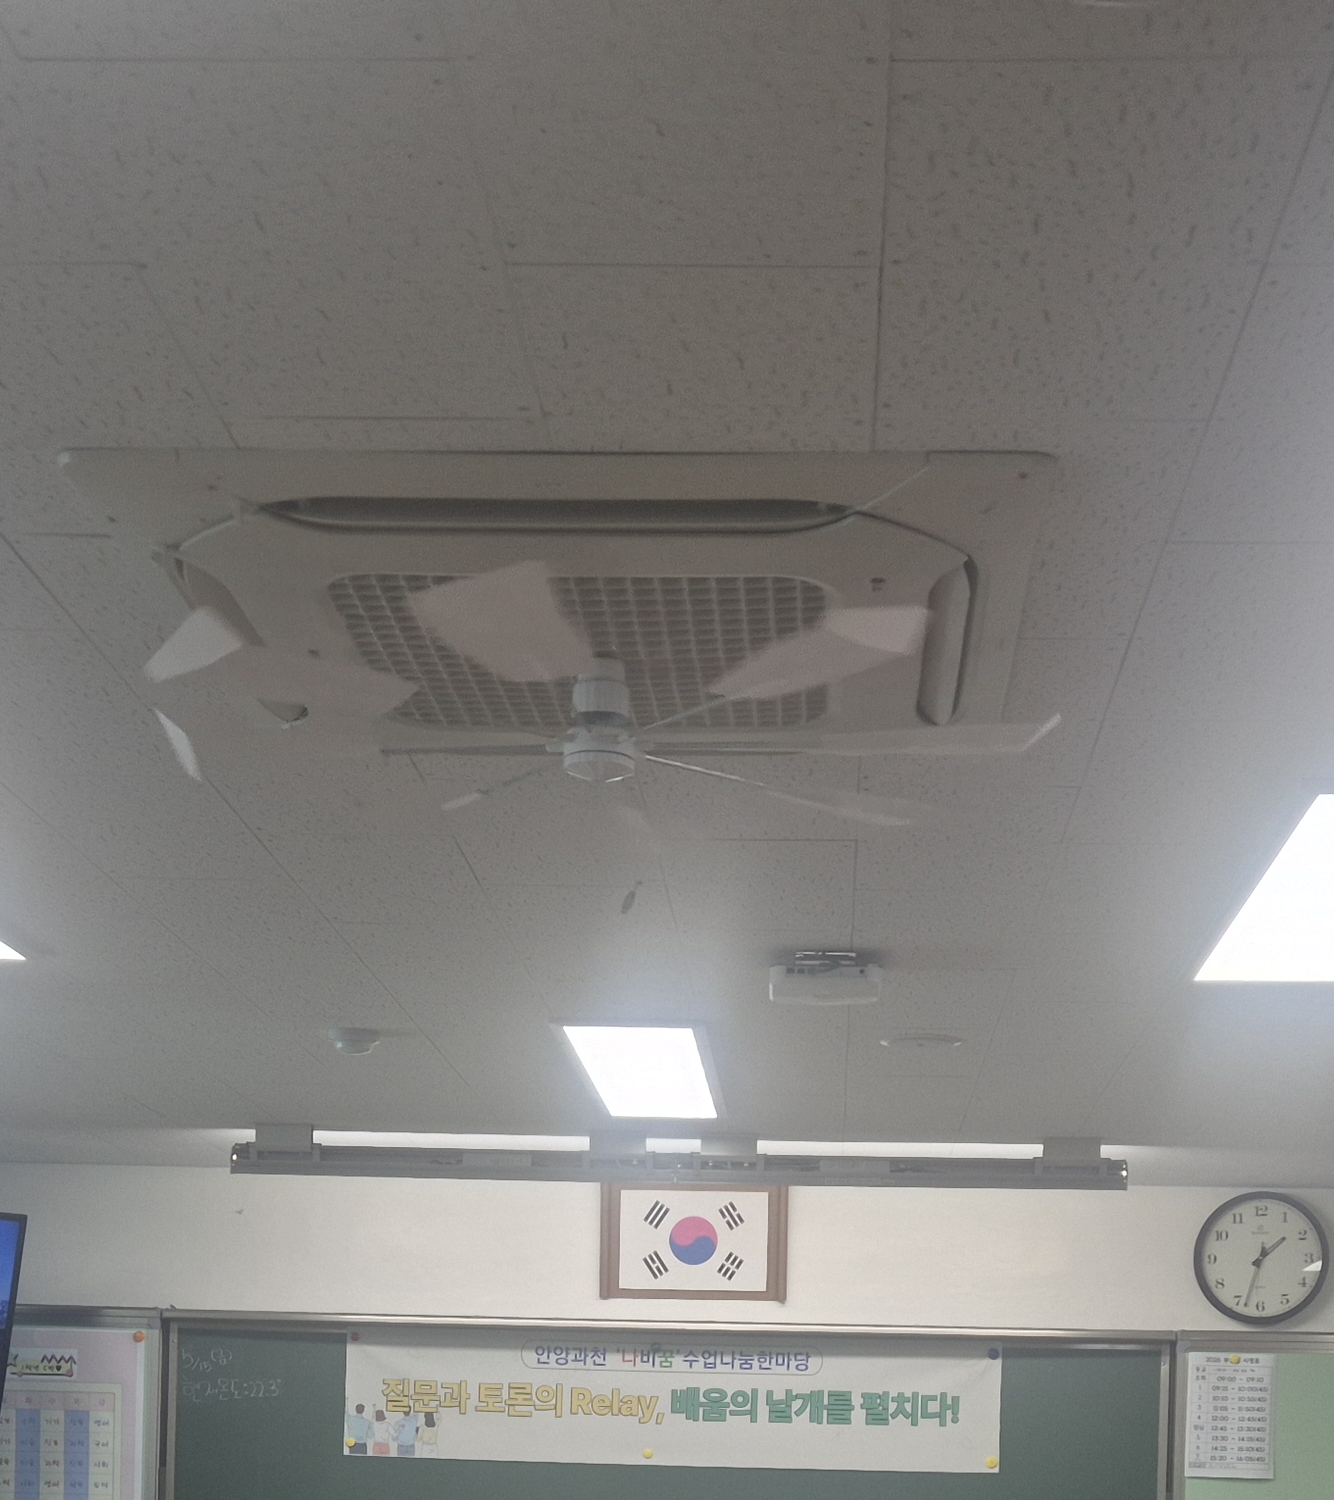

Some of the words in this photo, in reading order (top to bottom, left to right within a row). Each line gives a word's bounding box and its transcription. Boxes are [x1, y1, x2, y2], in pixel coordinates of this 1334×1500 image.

[1254, 1204, 1268, 1217] 12
[1232, 1212, 1244, 1224] 11
[1282, 1211, 1288, 1223] 1
[1214, 1229, 1229, 1242] 10
[1298, 1229, 1308, 1241] 2
[1207, 1253, 1218, 1265] 9
[1304, 1252, 1314, 1264] 3
[1214, 1277, 1225, 1290] 8
[1298, 1276, 1308, 1288] 4
[1233, 1294, 1243, 1307] 7
[1279, 1293, 1290, 1306] 5
[1255, 1300, 1266, 1312] 6
[534, 1345, 608, 1366] 안양과천
[381, 1378, 471, 1415] 질문과
[475, 1382, 563, 1418] 토론의
[570, 1386, 666, 1425] Relay,
[670, 1386, 759, 1424] 배움의
[766, 1388, 855, 1425] 날개를
[860, 1390, 960, 1427] 펼치다!
